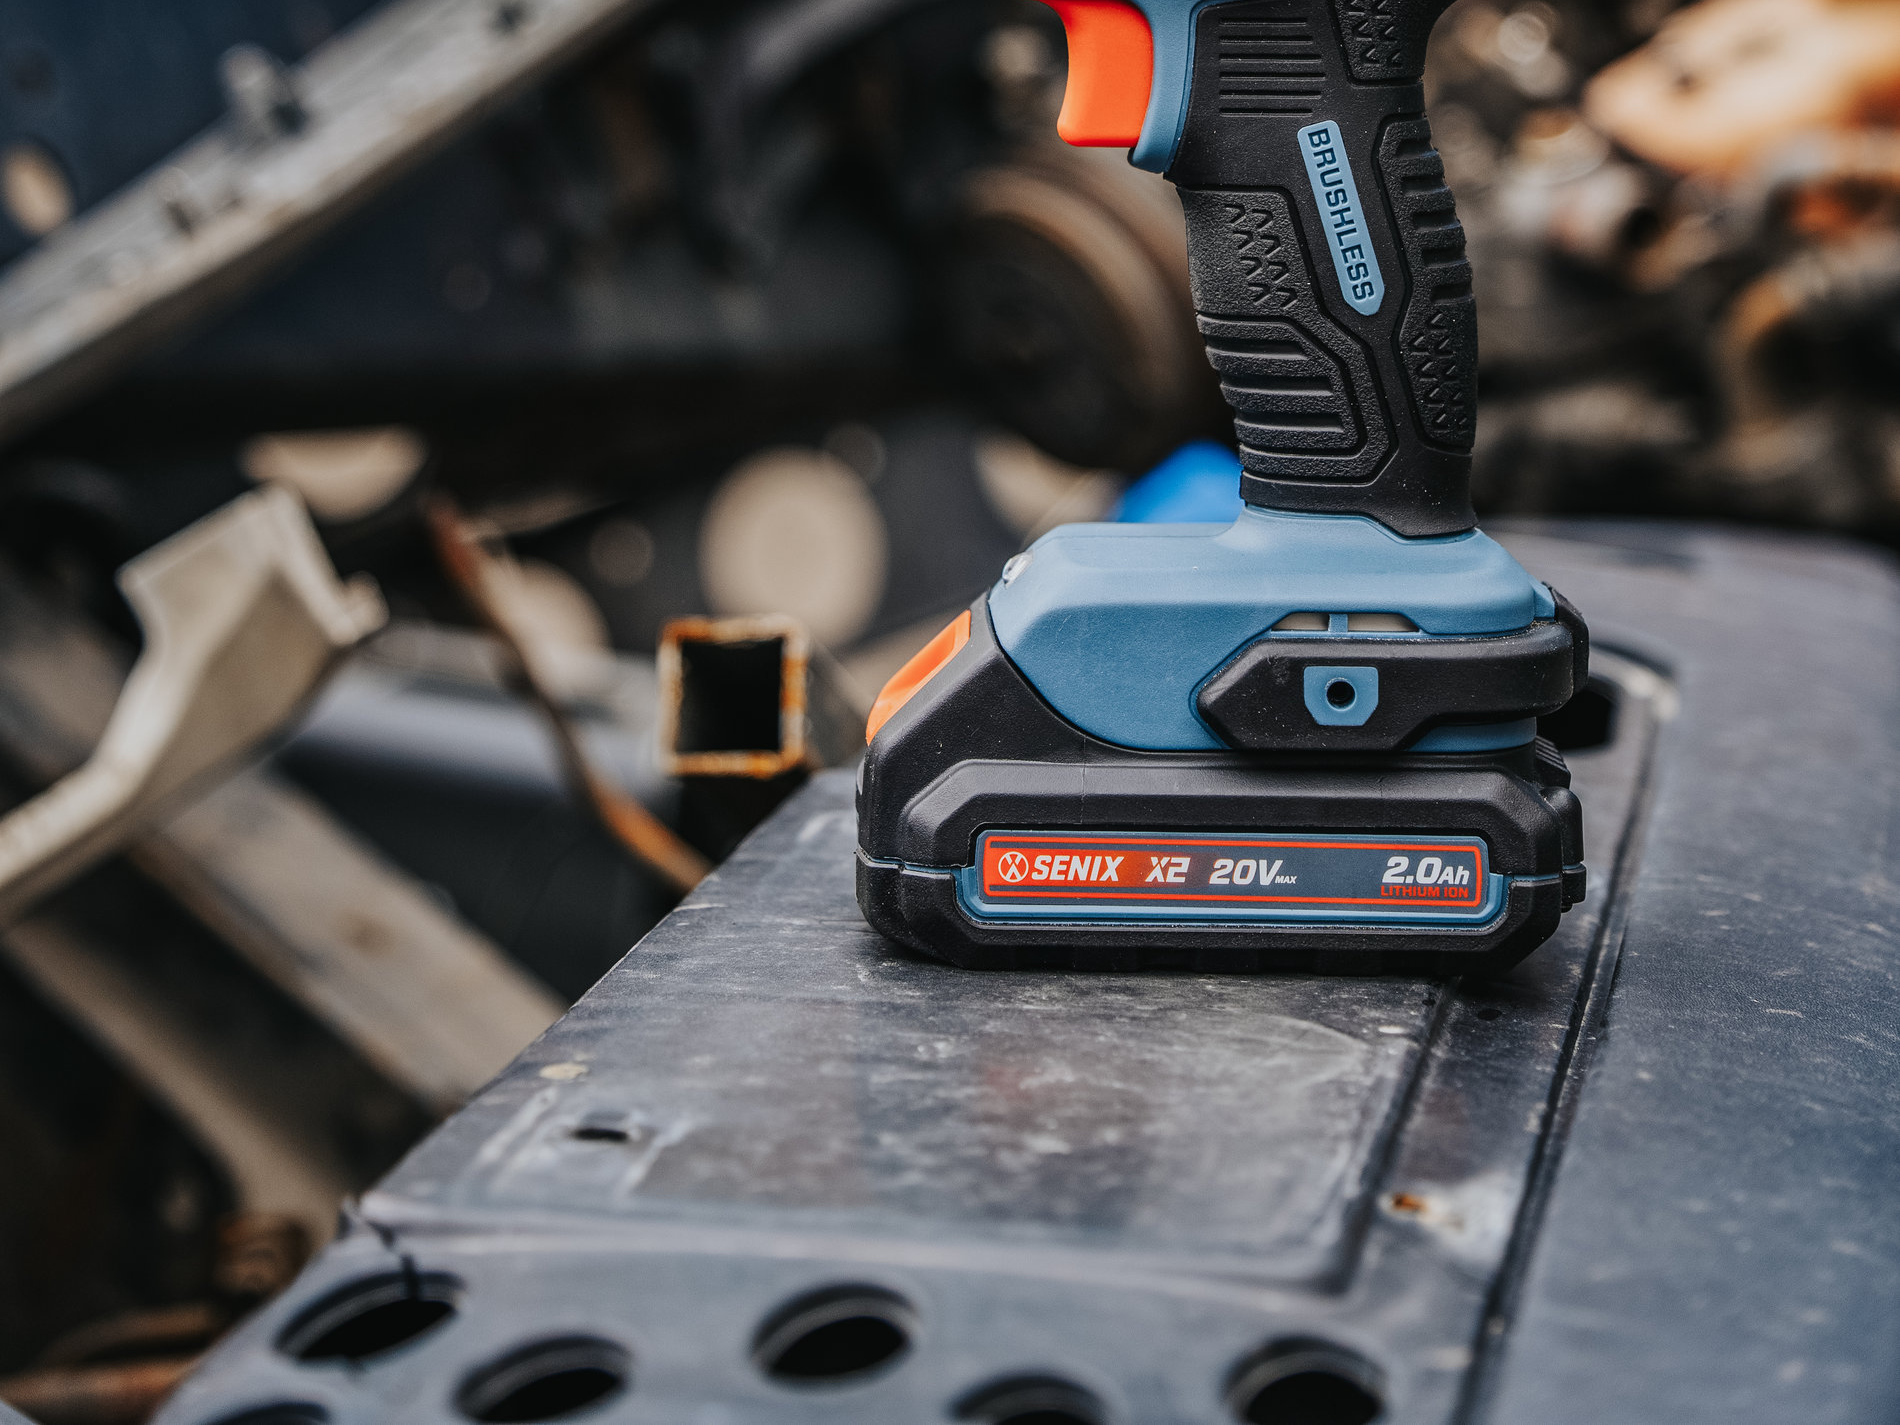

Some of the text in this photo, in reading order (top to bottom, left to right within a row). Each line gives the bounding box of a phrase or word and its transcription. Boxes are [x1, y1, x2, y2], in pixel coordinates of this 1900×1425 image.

[1307, 127, 1375, 302] BRUSHLESS
[1031, 855, 1125, 883] SENIX
[1145, 856, 1191, 883] X2
[1381, 856, 1470, 885] 2.0Ah
[1380, 885, 1470, 899] LITHIUM ION
